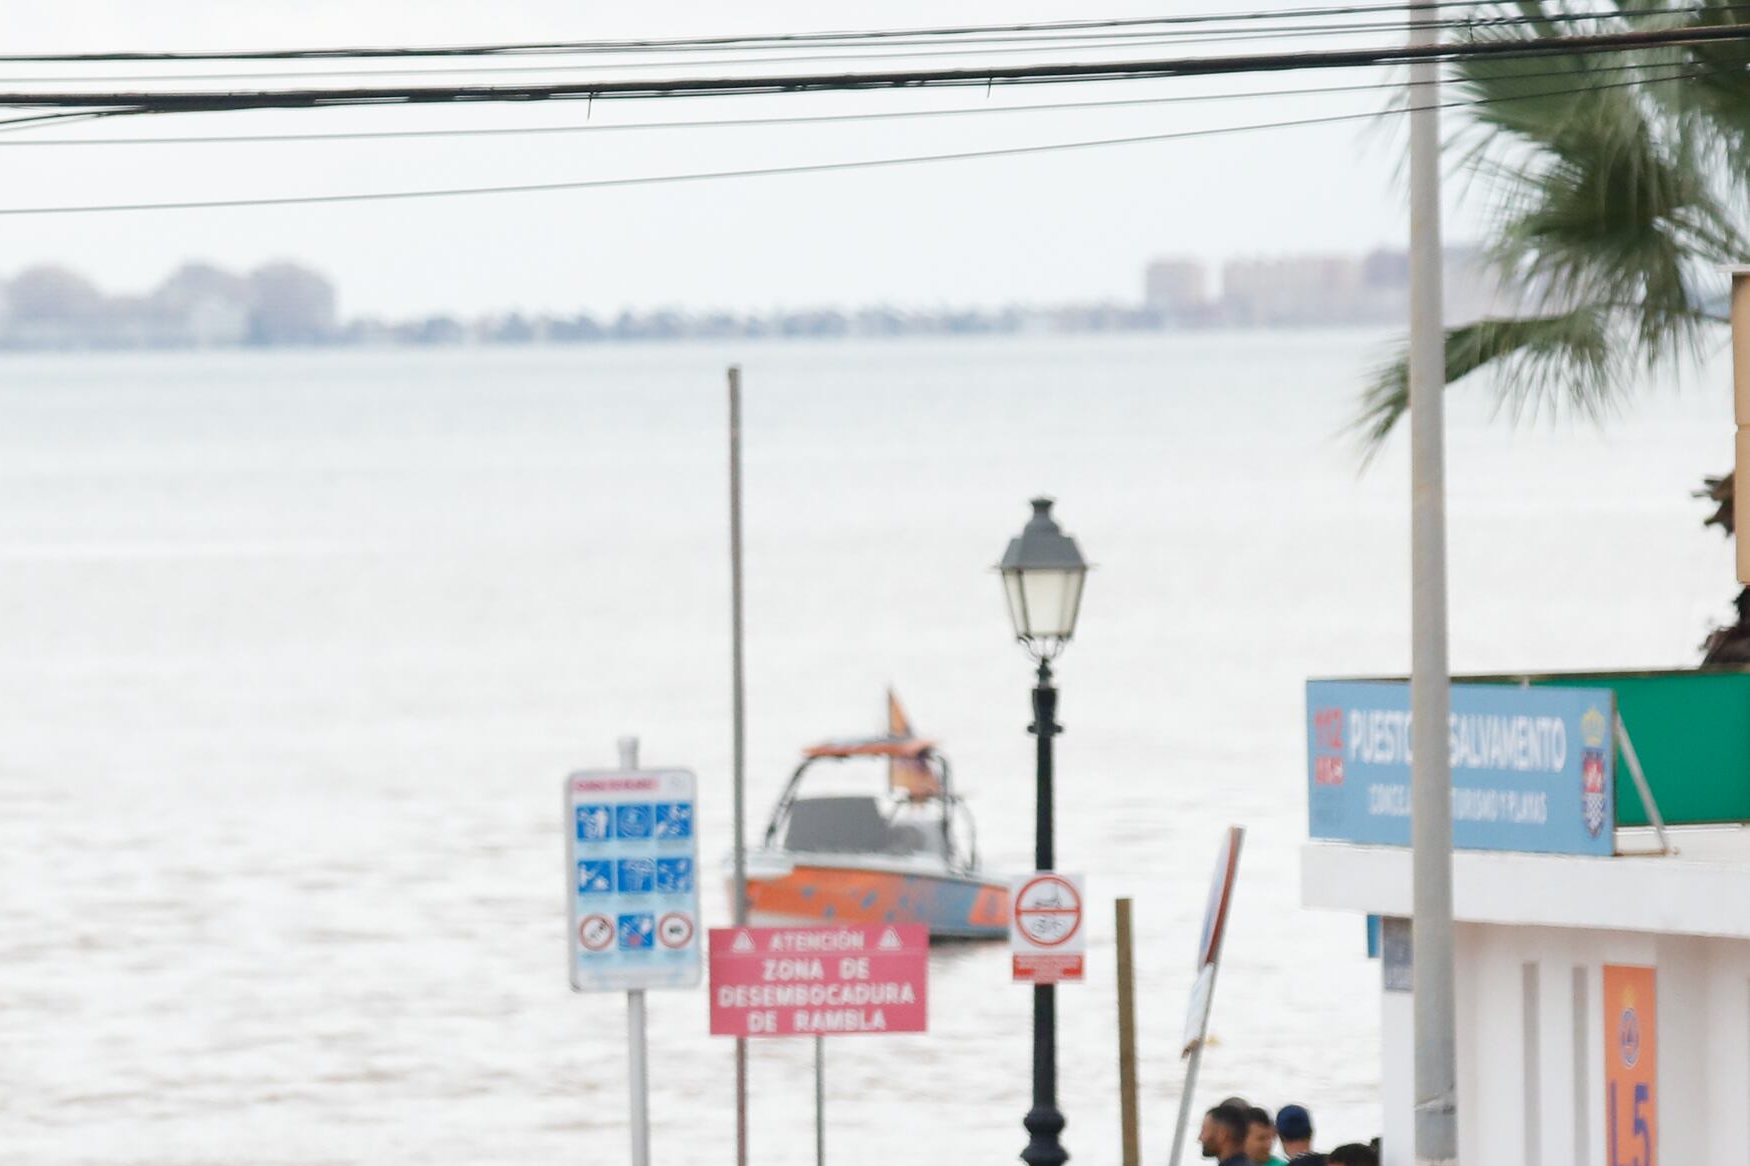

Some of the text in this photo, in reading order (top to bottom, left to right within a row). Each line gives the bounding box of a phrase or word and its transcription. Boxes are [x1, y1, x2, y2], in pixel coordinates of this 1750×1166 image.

[1448, 712, 1567, 774] SALVAMENTO
[769, 927, 865, 952] ATENCIÓN
[763, 957, 870, 981] ZONA DE
[717, 982, 916, 1008] DESEMBOCADURA
[747, 1008, 887, 1033] DE RAMBLA
